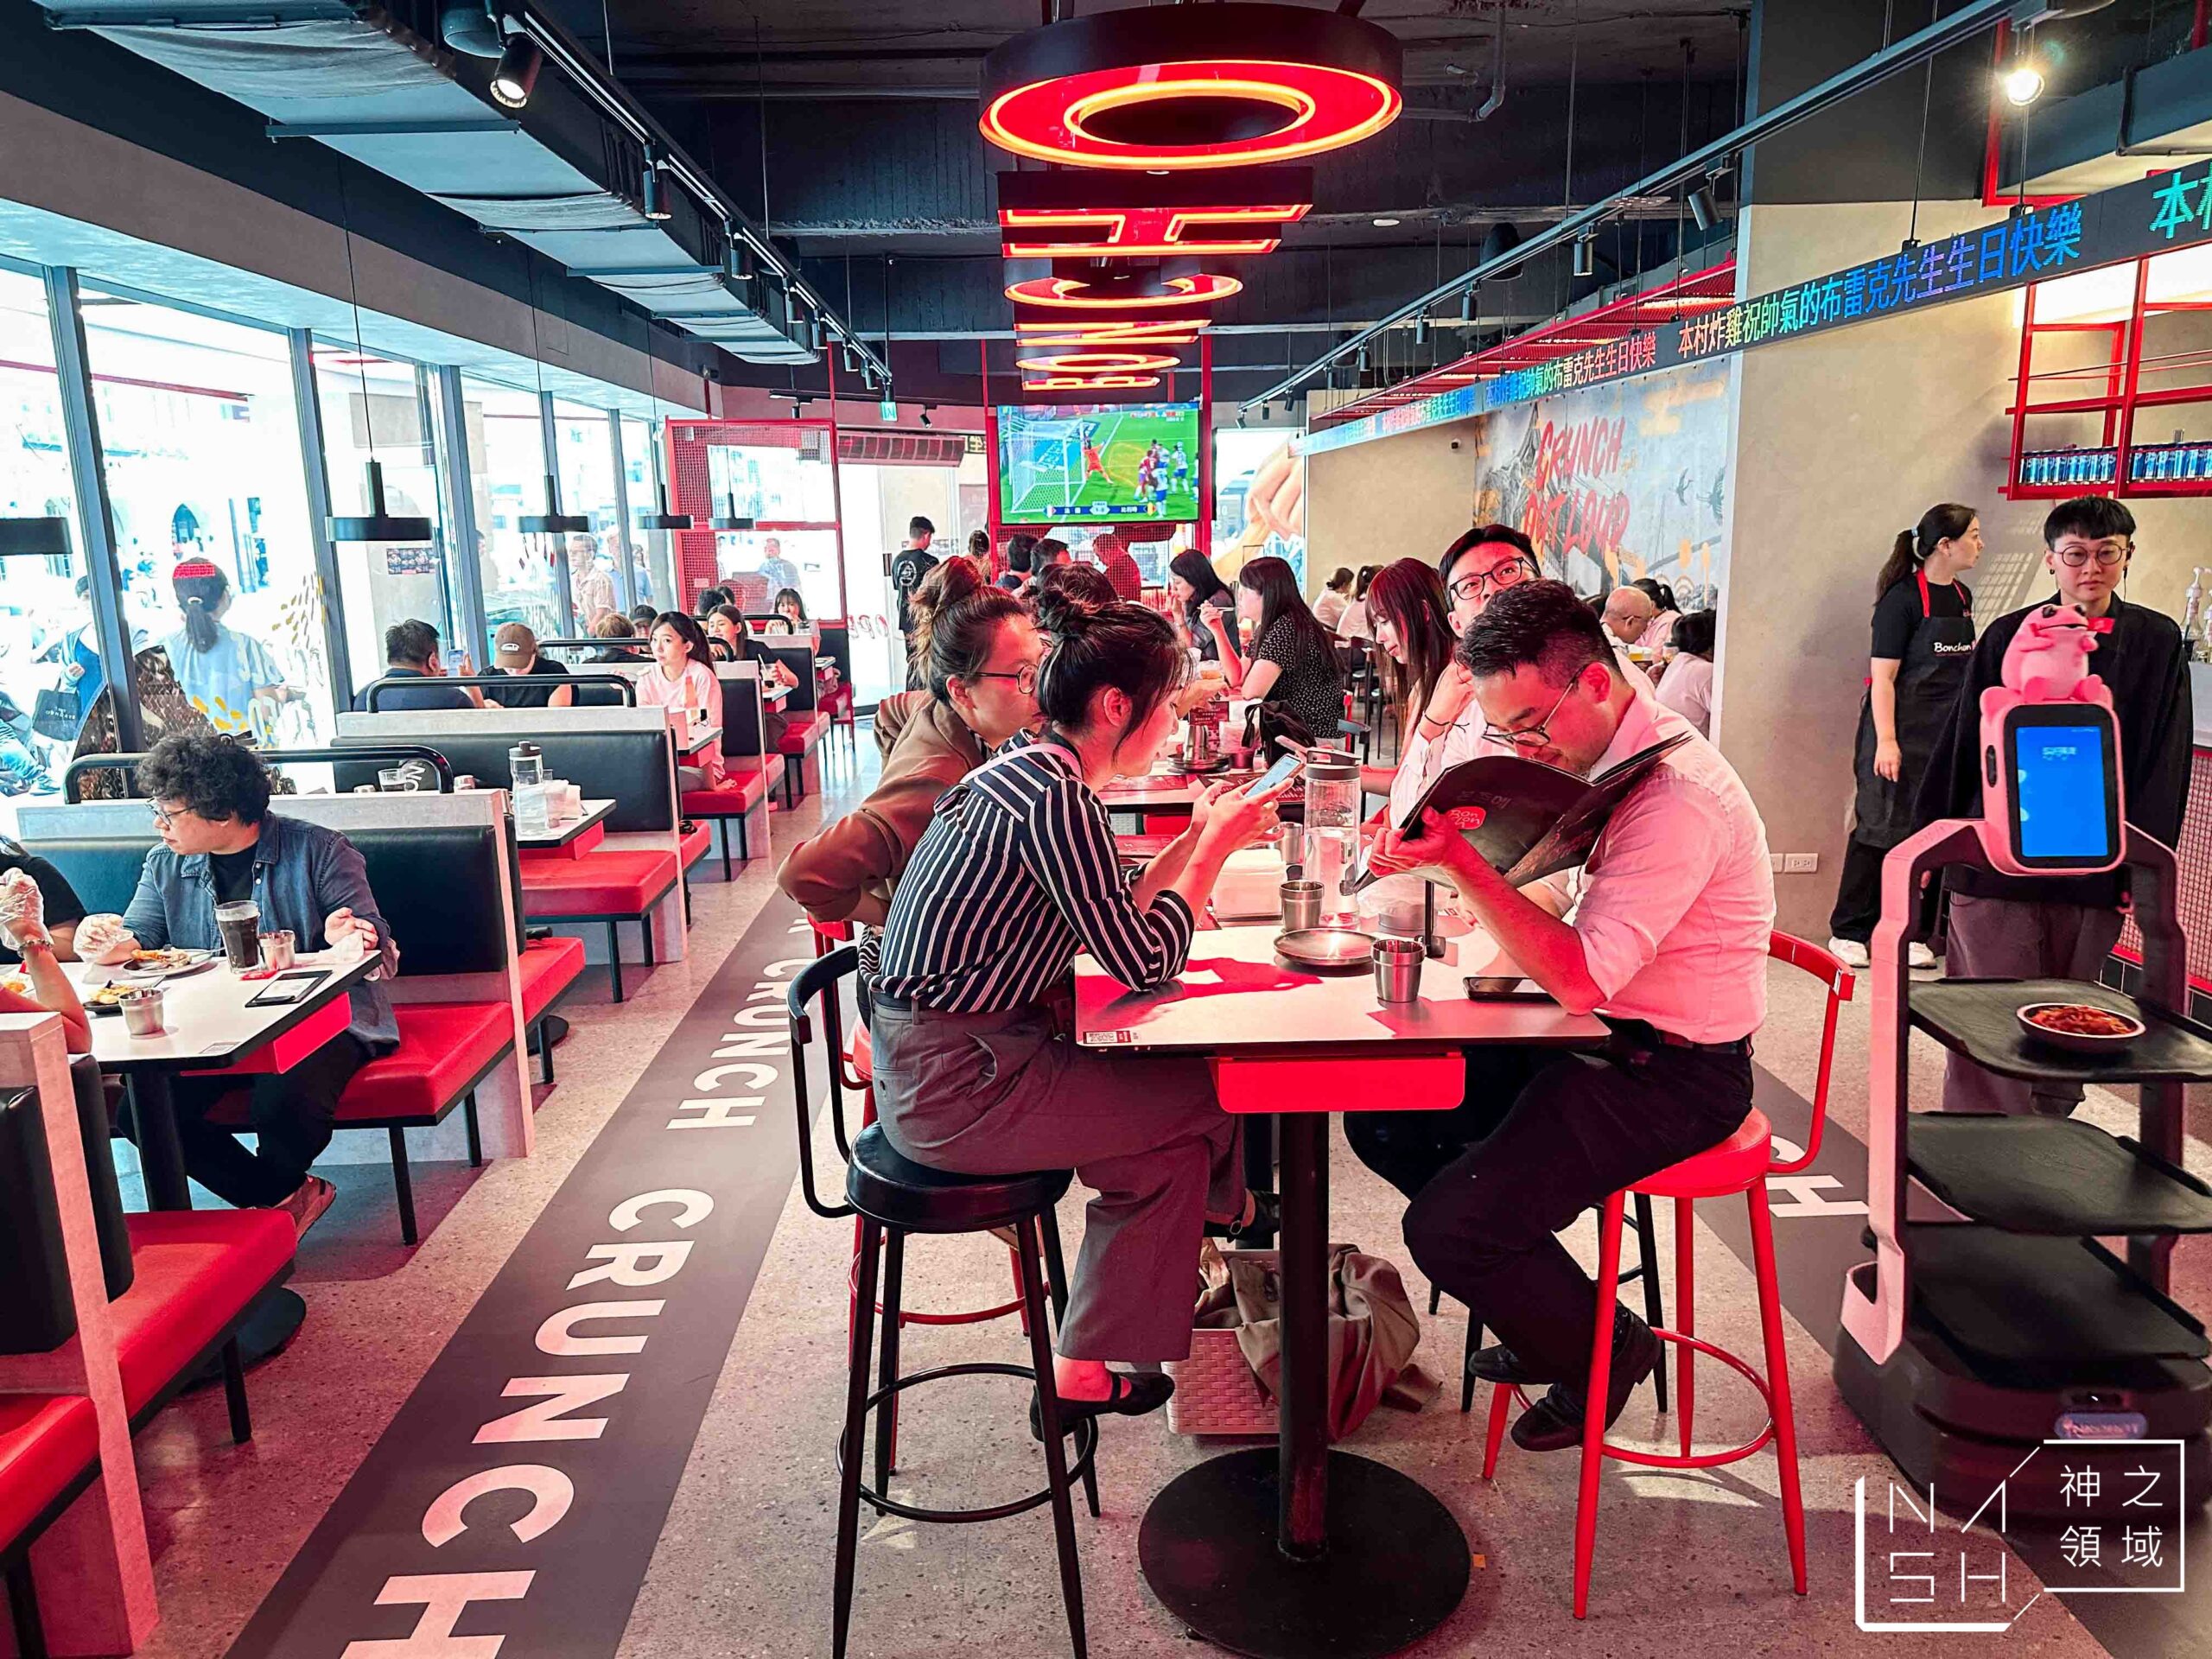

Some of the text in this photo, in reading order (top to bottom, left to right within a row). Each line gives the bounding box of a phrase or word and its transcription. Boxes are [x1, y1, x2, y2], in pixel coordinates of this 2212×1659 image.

[1678, 201, 2083, 359] 本村炸雞祝帥氣的布雷克先生生日快樂
[1535, 414, 1626, 492] CRUNCH
[1562, 487, 1630, 555] LOUD
[1934, 642, 1972, 653] Bonchon
[340, 1187, 715, 1659] CRUNCH
